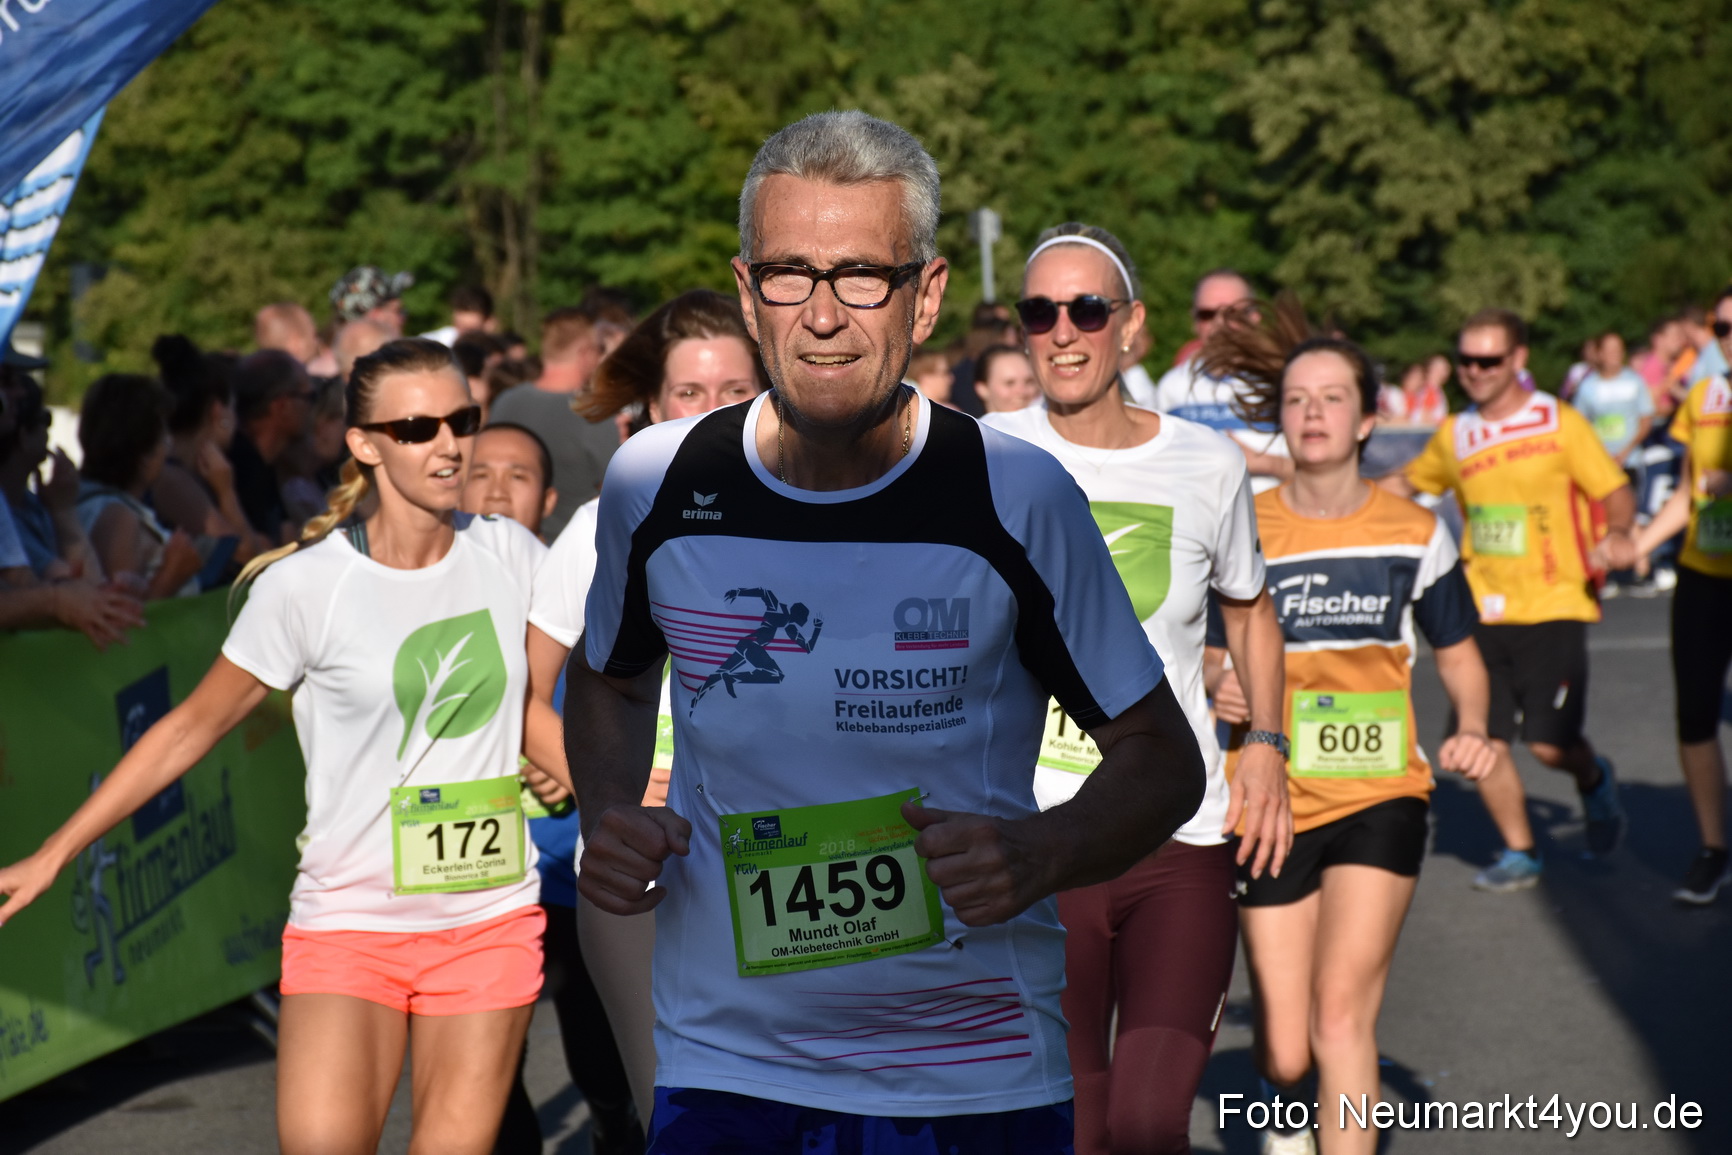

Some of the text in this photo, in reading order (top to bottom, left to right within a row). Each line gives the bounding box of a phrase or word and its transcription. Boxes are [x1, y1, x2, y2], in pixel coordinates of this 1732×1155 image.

[682, 508, 722, 520] erima
[893, 597, 971, 632] OM
[1283, 590, 1392, 617] Fischer
[1294, 613, 1385, 628] AUTOMOBILE
[895, 630, 968, 641] KLEBE TECHNIK
[834, 665, 968, 690] VORSICHT!
[834, 695, 964, 719] Freilaufende
[836, 715, 966, 735] Klebebandspezialisten
[1048, 739, 1084, 753] Kohler
[1319, 723, 1382, 754] 608
[427, 818, 501, 861] 172
[743, 832, 808, 852] firmenlauf
[819, 839, 856, 856] 2018
[422, 857, 507, 875] Eckerlein Corina
[749, 854, 906, 927] 1459
[789, 917, 877, 943] Mundt Olaf
[771, 936, 862, 958] OM-Klebetechnik
[865, 929, 900, 945] GmbH
